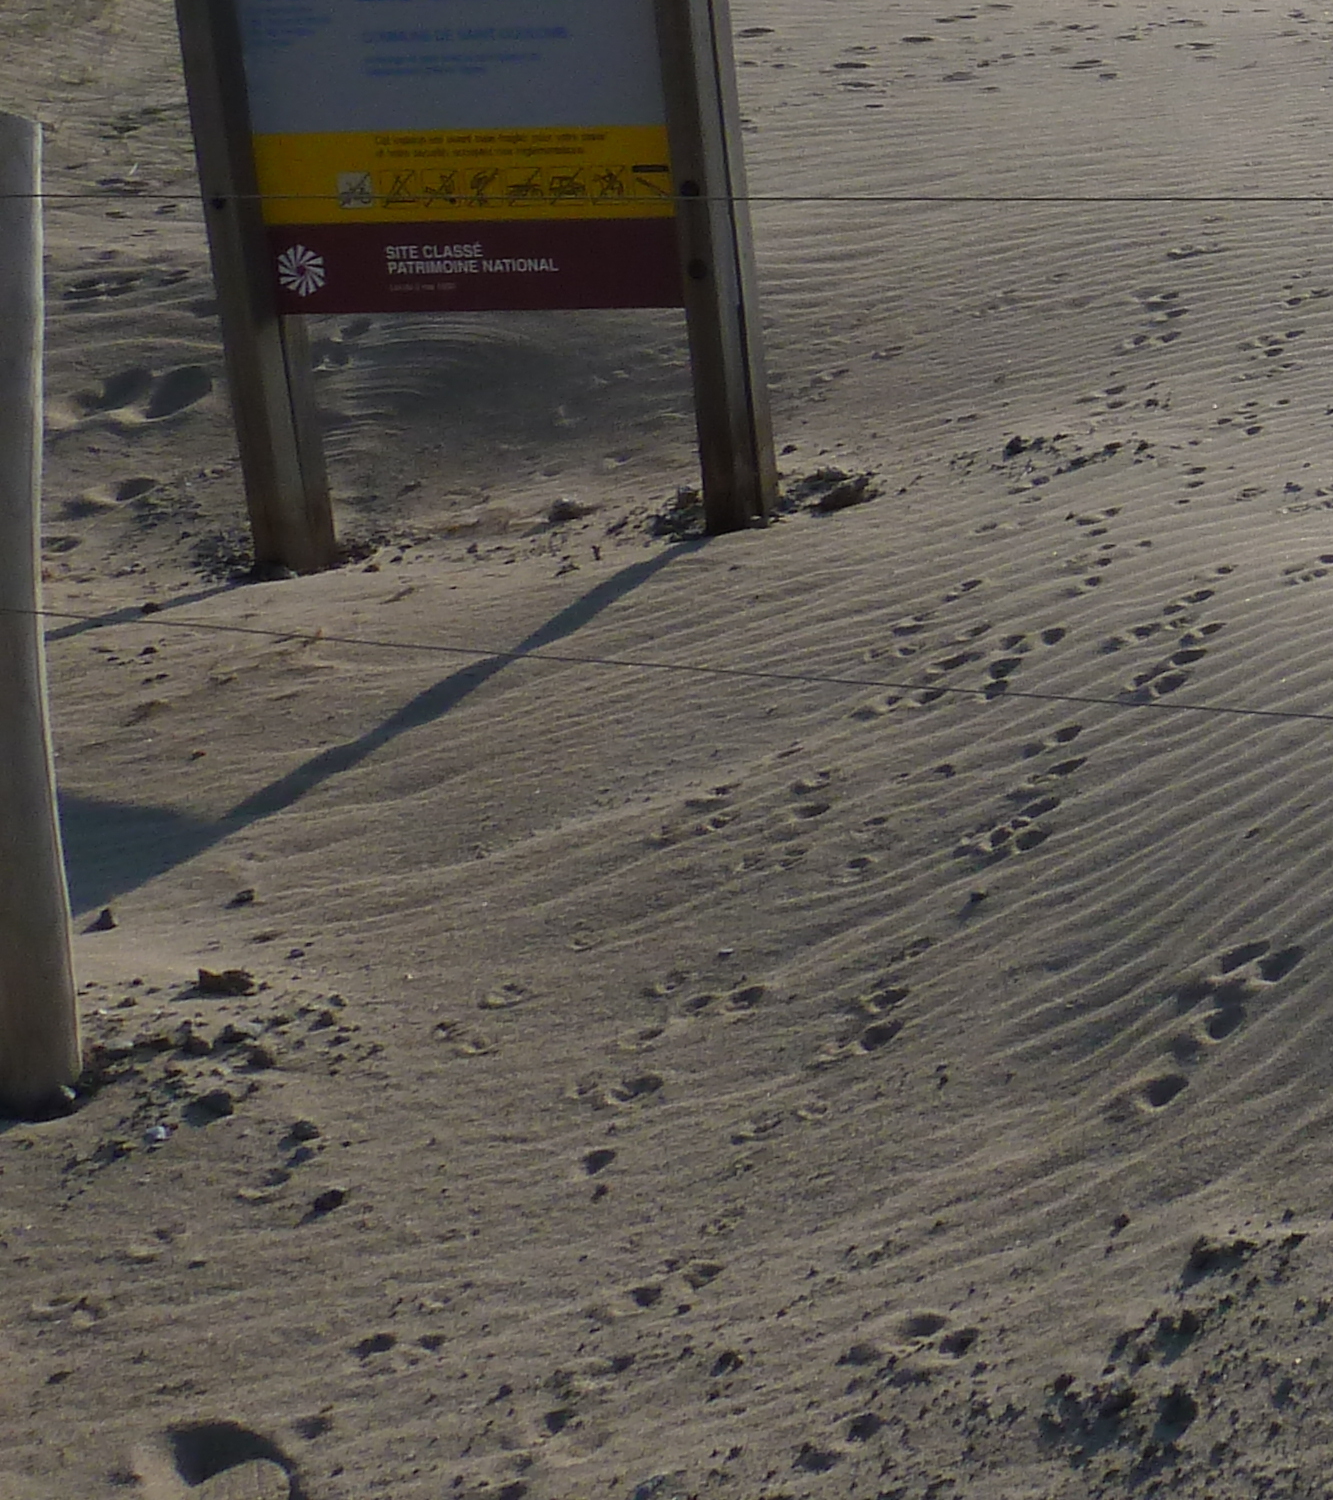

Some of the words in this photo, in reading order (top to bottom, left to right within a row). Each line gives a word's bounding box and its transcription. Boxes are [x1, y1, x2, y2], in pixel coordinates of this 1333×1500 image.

[385, 245, 419, 260] SITE
[421, 241, 484, 259] CLASSÉ
[387, 260, 480, 276] PATRIMOINE
[482, 258, 561, 273] NATIONAL
